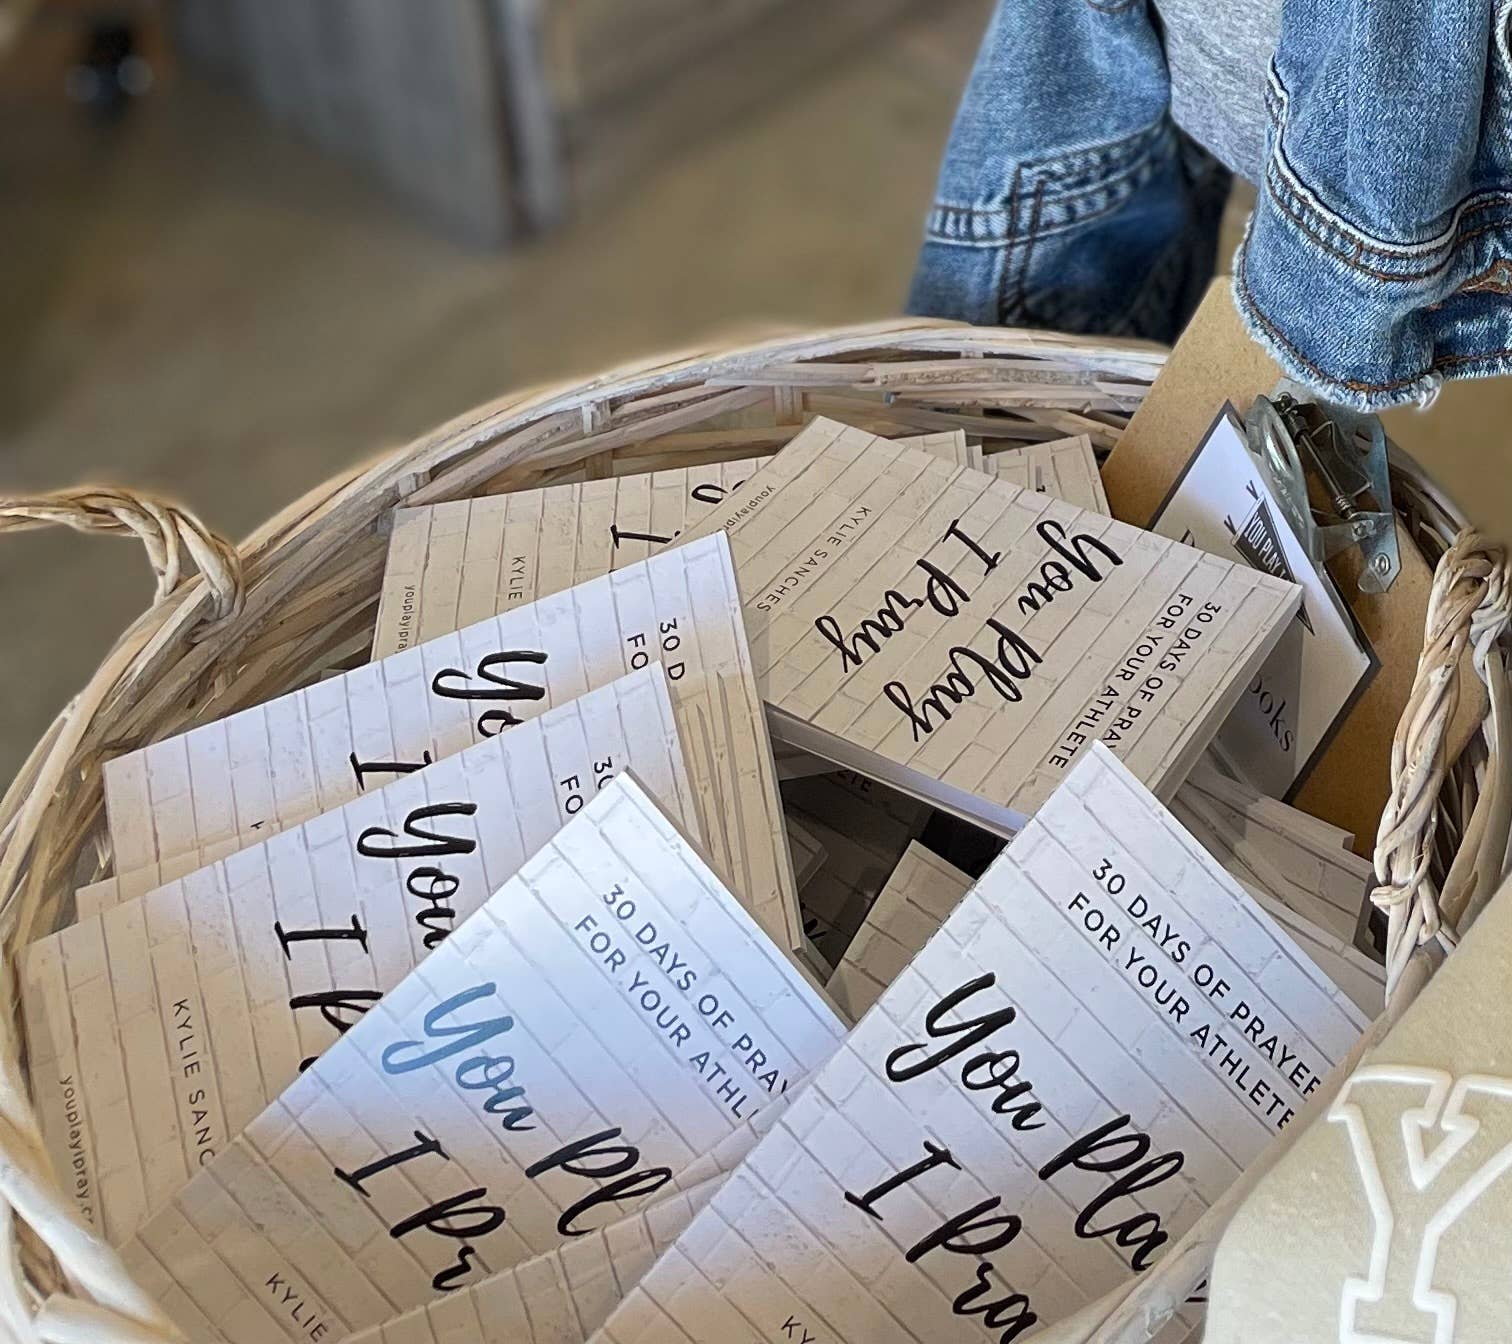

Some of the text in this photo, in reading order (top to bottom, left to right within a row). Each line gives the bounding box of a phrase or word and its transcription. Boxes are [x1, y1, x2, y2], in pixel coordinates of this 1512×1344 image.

[722, 484, 776, 531] youplayipr
[942, 518, 1002, 577] I
[1244, 511, 1282, 574] YOU PLAY
[507, 555, 527, 601] KYLIE
[756, 506, 872, 612] KYLIE SANCHES
[1017, 519, 1124, 617] You
[396, 584, 415, 656] youplayipra
[627, 633, 649, 671] FO
[660, 618, 679, 652] 30
[432, 650, 549, 738] Yo
[1048, 593, 1194, 769] FOR YOUR ATHLETE
[1102, 601, 1222, 749] 30 DAYS OF PRA
[1248, 670, 1294, 752] ooks
[560, 775, 584, 815] FO
[275, 914, 369, 961] I
[603, 884, 637, 921] 30
[636, 923, 697, 991] DAYS
[698, 994, 735, 1030] OF
[1091, 858, 1127, 896] 30
[1127, 895, 1191, 964] DAYS
[1194, 963, 1232, 1000] OF
[574, 915, 760, 1121] FOR YOUR ATHL
[1068, 891, 1295, 1130] FOR YOUR ATHLETE
[172, 998, 216, 1167] KYLIE SANC
[382, 981, 673, 1237] You Pl
[886, 971, 1185, 1272] You Pla
[334, 1130, 506, 1291] I Pr
[844, 1140, 1038, 1344] I Pra
[265, 1272, 328, 1343] KYLIE
[781, 1315, 816, 1344] KY
